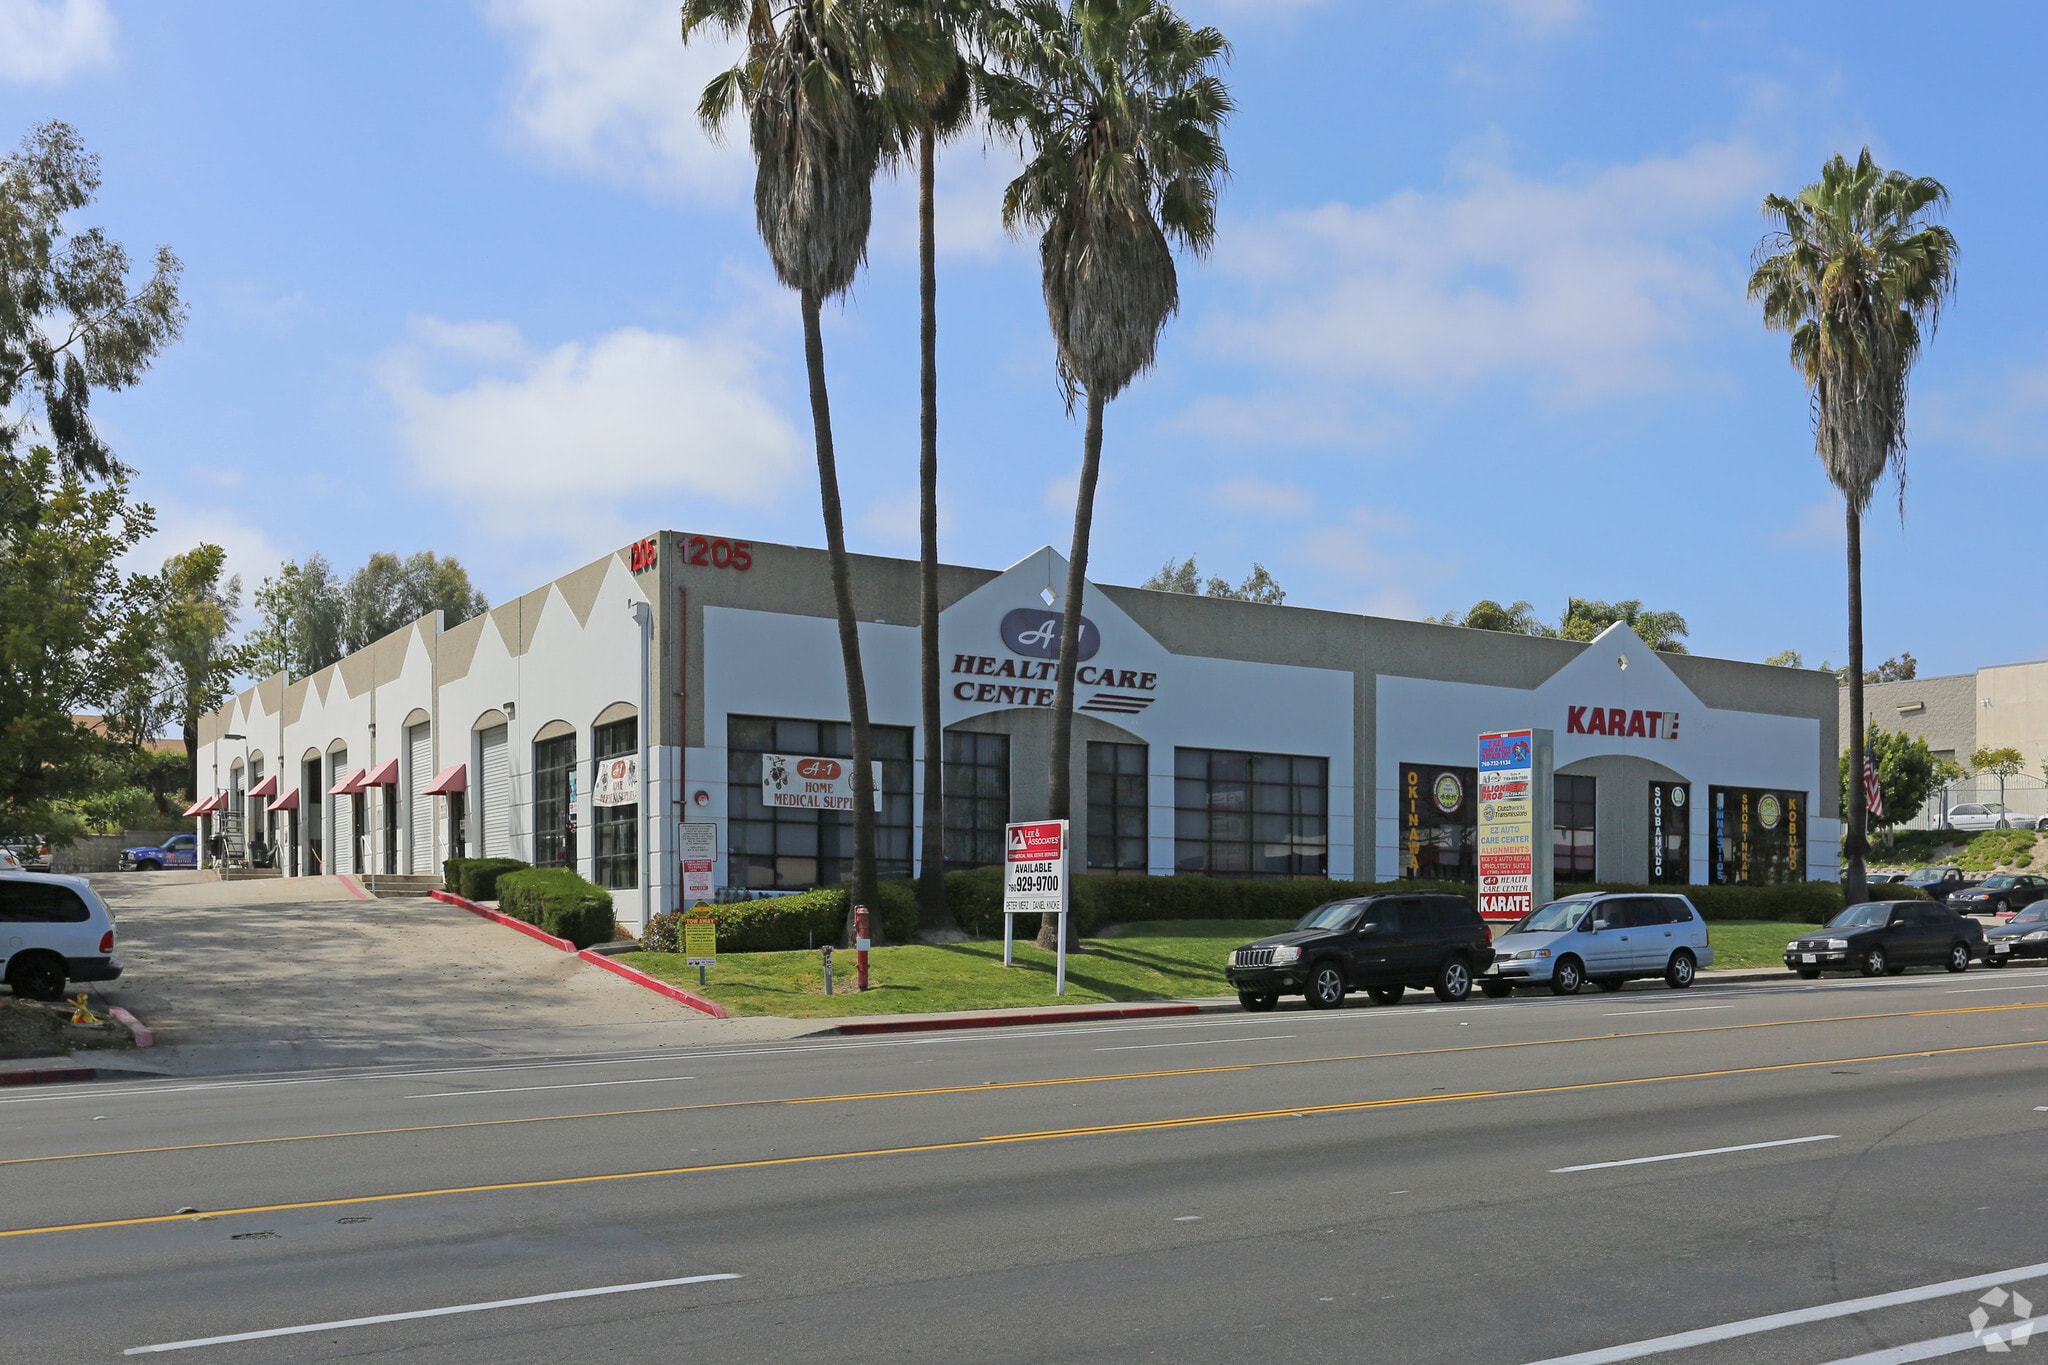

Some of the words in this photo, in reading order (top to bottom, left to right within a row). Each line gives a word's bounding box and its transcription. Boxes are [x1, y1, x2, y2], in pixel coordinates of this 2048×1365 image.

[678, 535, 752, 571] 1205
[951, 653, 1157, 691] HEALTCARE
[953, 681, 1057, 707] CENTE
[1567, 705, 1679, 739] KARATE
[802, 761, 834, 776] A-1
[805, 782, 834, 793] HOME
[1481, 783, 1529, 792] ALIGNMENT
[774, 793, 820, 807] MEDICAL
[824, 795, 855, 809] SUPPL
[1481, 793, 1503, 801] PROS
[1407, 771, 1420, 869] OKINAWA
[1035, 828, 1040, 837] &
[1654, 787, 1662, 876] SOOBAHKDO
[1788, 798, 1798, 871] KOBUDO
[1028, 836, 1058, 845] ASSOCIATES
[1481, 846, 1530, 854] ALIGNMENTS
[1015, 863, 1052, 873] AVAILABLE
[1016, 875, 1059, 891] 929-9700
[1480, 895, 1530, 912] KARATE
